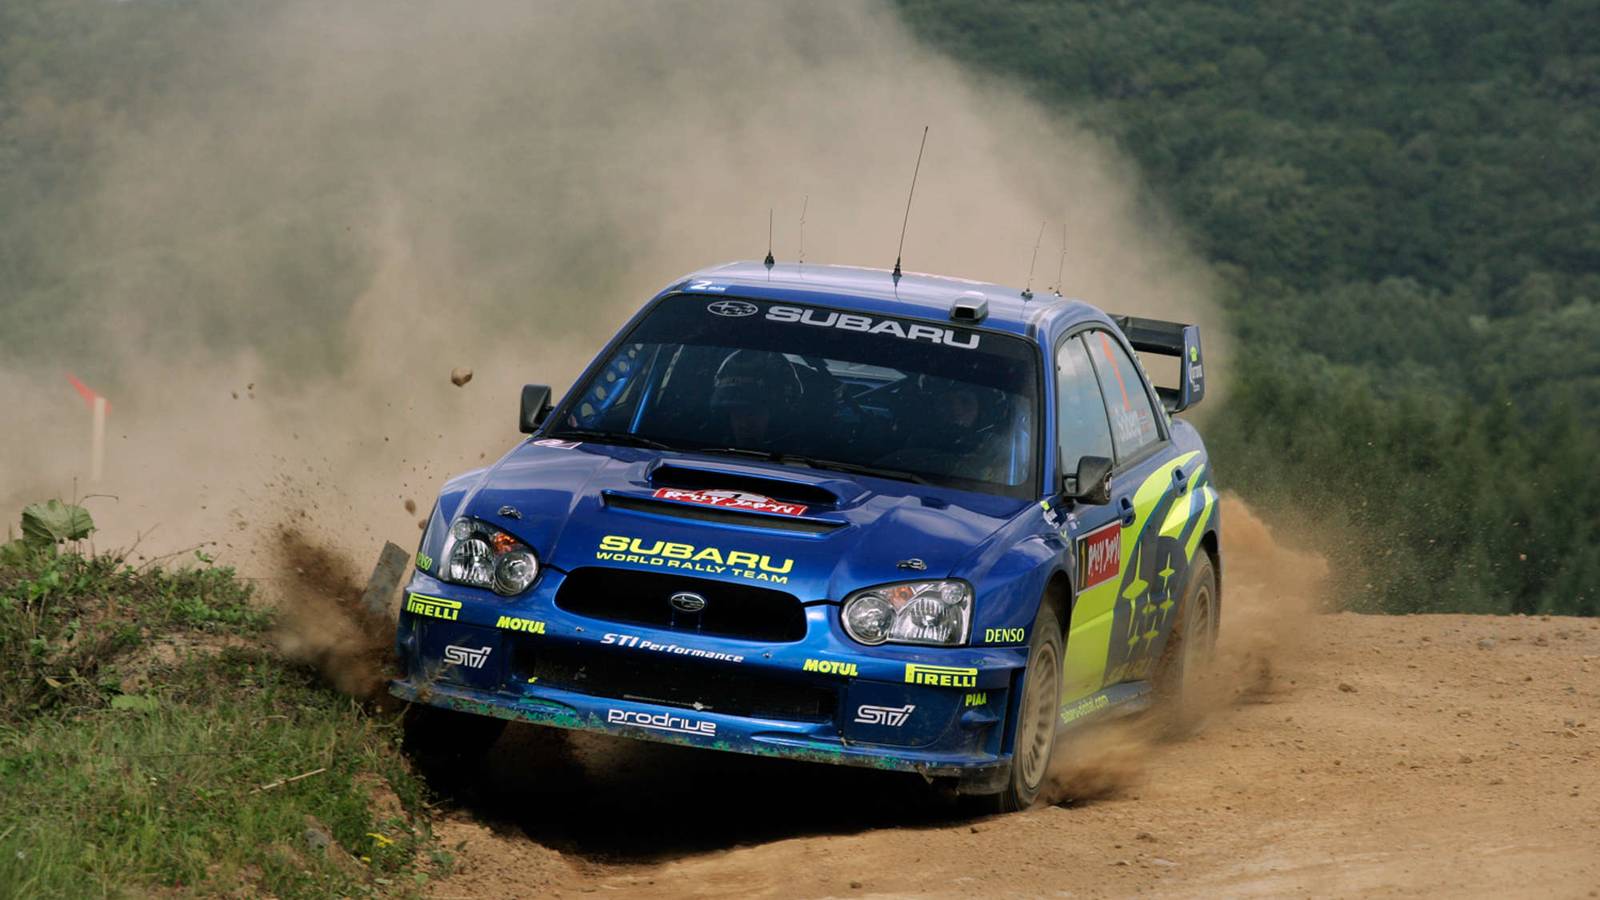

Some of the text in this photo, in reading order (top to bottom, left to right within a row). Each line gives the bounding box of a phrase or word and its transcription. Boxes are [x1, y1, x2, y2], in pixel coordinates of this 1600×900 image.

[765, 305, 980, 349] SUBARU
[596, 551, 788, 585] WORLD RALLY TEAM
[599, 535, 794, 574] SUBARU
[407, 592, 463, 621] PIRELLI
[496, 616, 546, 635] MOTUL
[985, 628, 1025, 643] DENSO
[600, 633, 744, 663] STI Performance
[802, 658, 859, 677] MOTUL
[904, 663, 978, 688] PIRELLI
[965, 692, 987, 706] PIAA
[607, 708, 717, 737] prodrive
